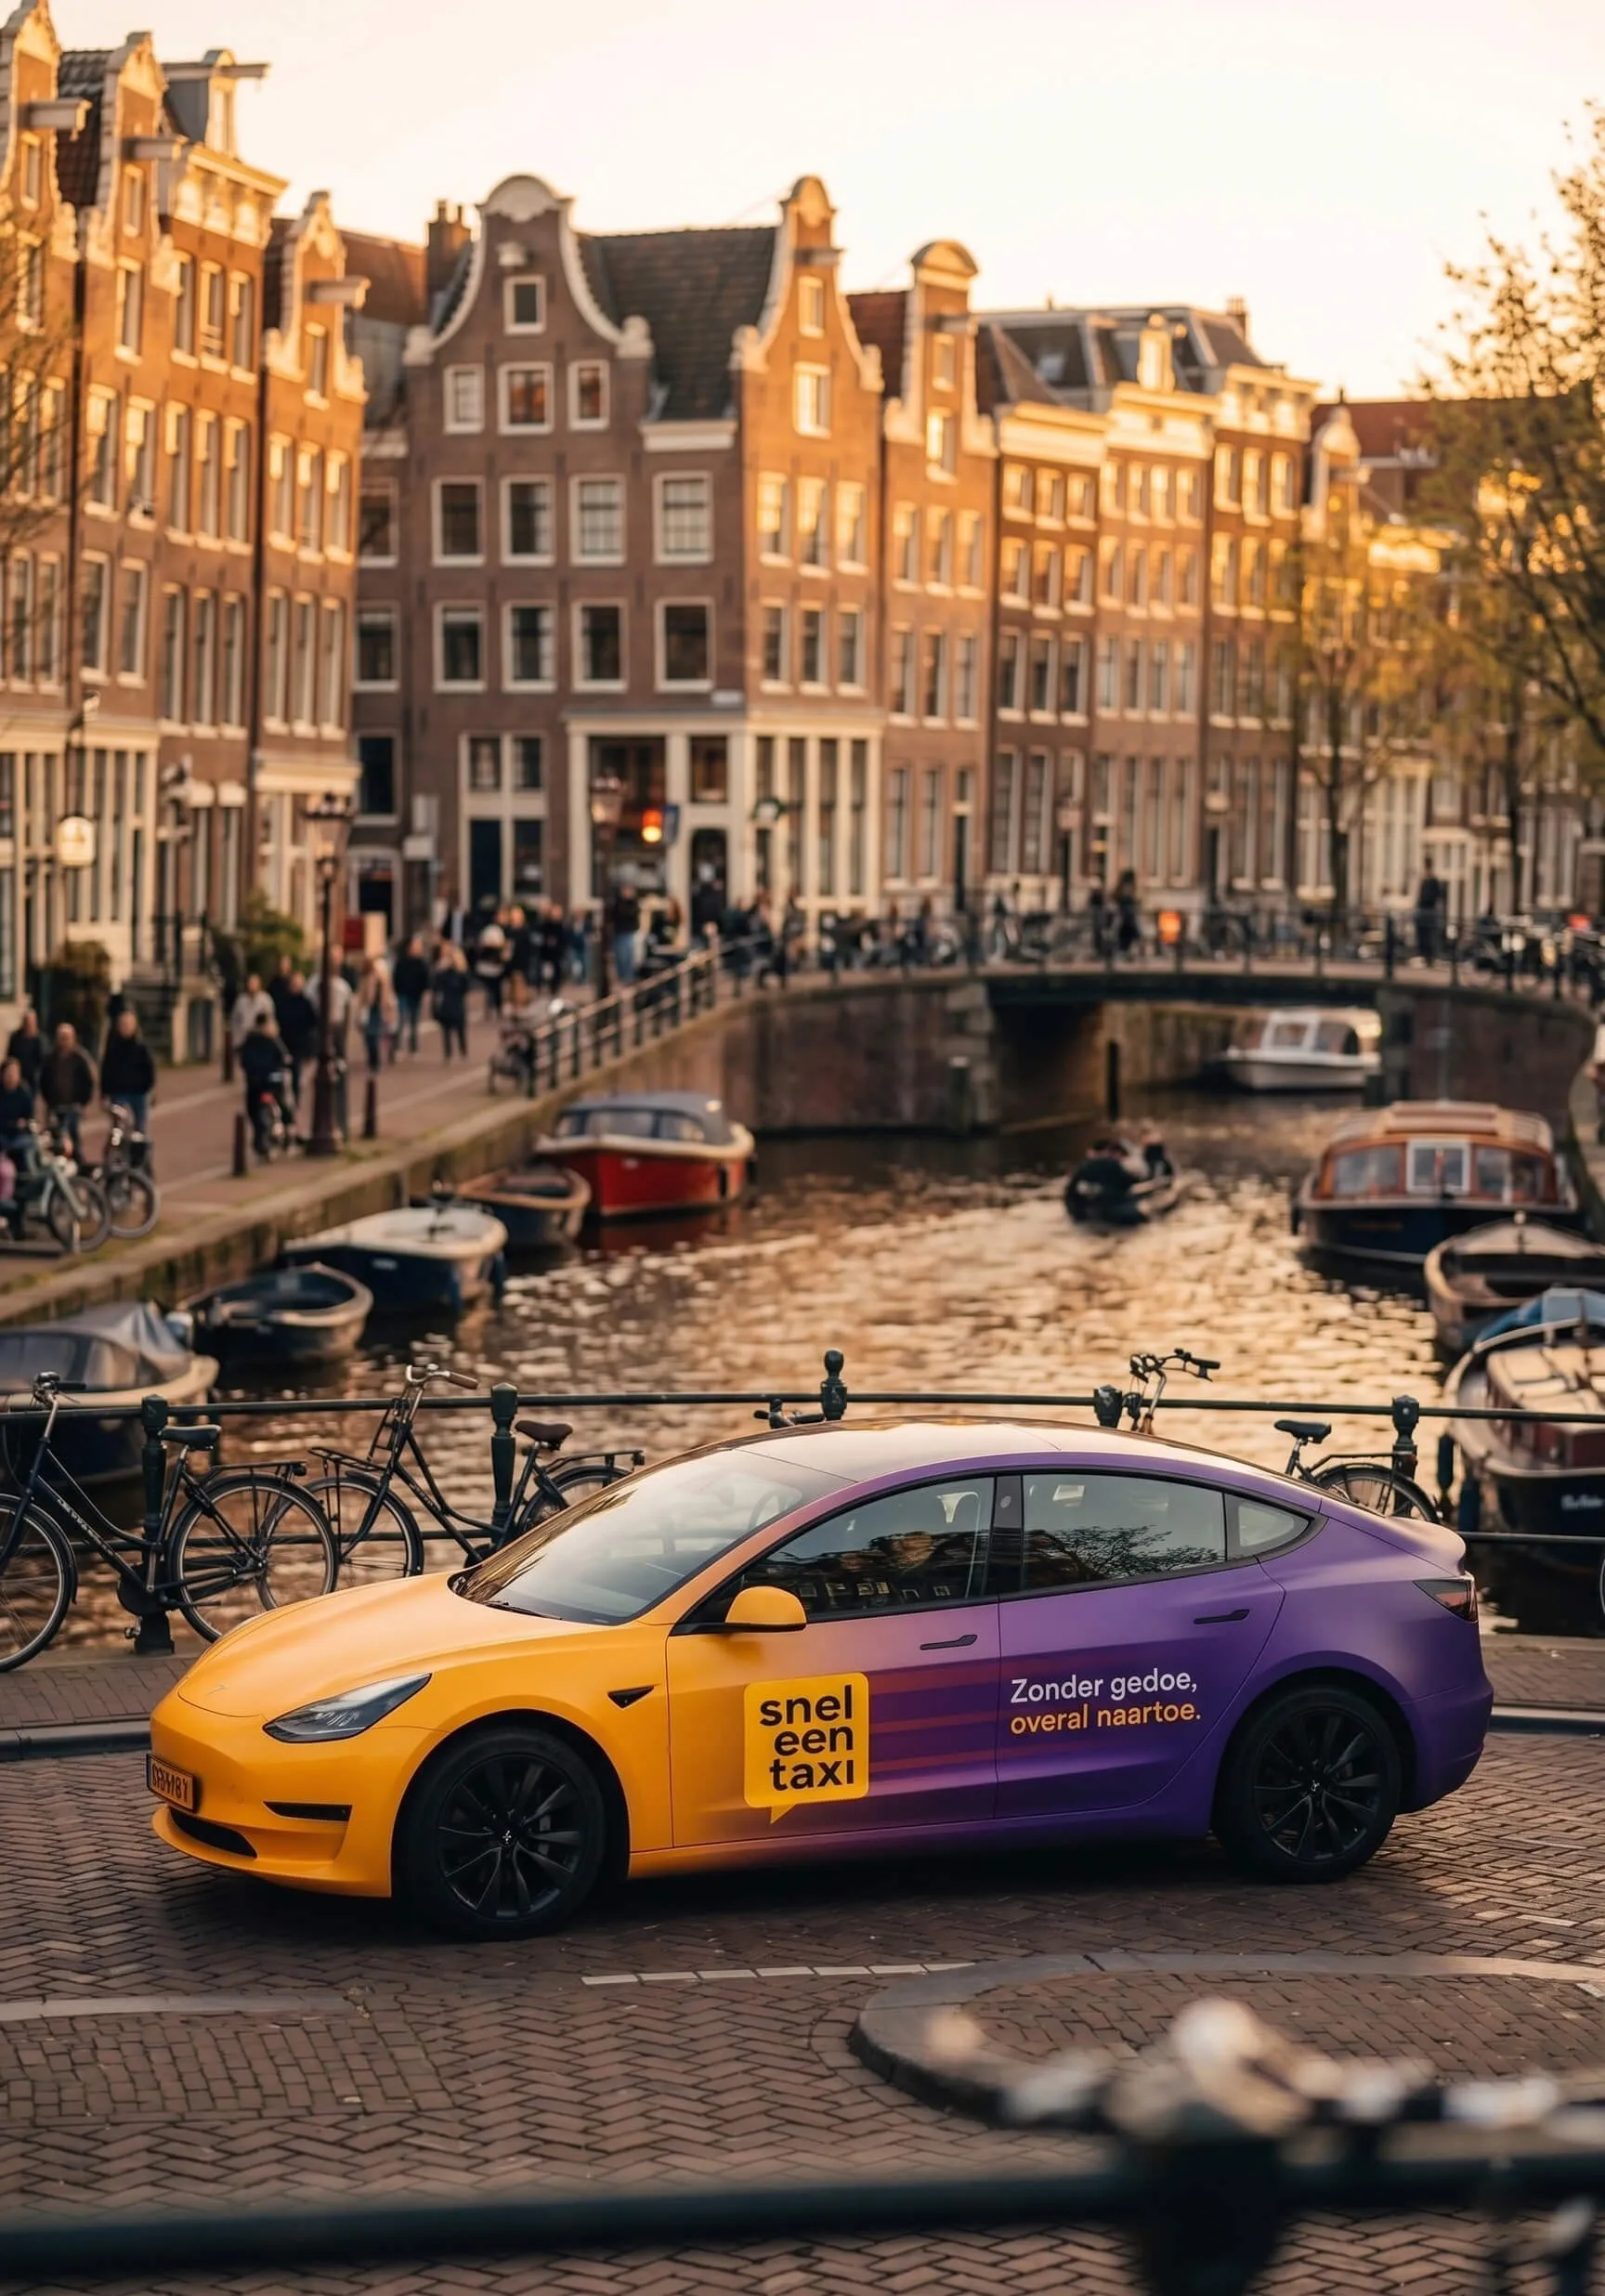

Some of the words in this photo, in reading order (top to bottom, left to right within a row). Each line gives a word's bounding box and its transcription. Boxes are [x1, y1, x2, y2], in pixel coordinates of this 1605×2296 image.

[1011, 1674, 1103, 1703] Zonder
[1110, 1667, 1197, 1701] gedoe,
[760, 1685, 852, 1727] snel
[1011, 1703, 1088, 1735] overal
[1097, 1702, 1201, 1728] naartoe.
[774, 1726, 854, 1756] een
[769, 1758, 854, 1792] taxi
